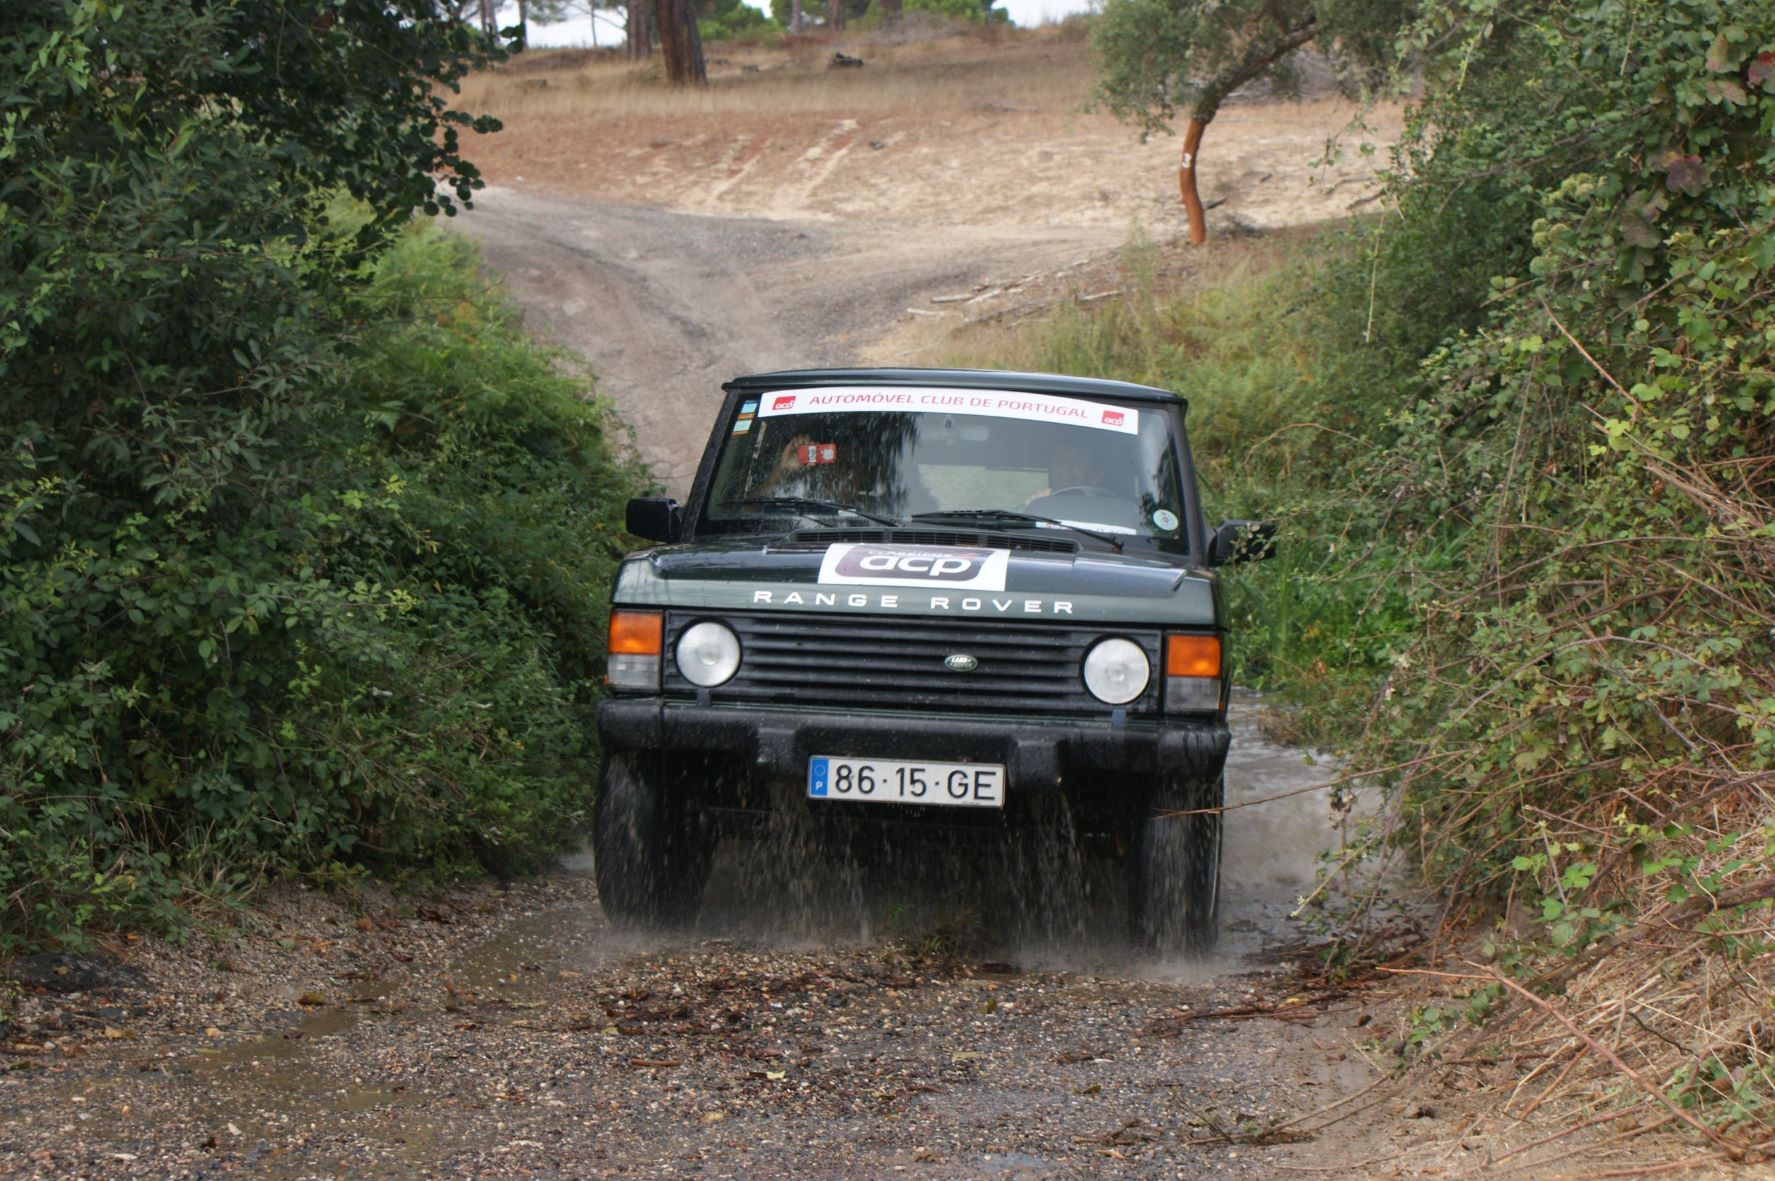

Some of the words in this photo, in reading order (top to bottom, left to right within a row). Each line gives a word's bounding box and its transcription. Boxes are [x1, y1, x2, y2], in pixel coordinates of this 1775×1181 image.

[809, 392, 914, 405] AUTOMÓVEL
[920, 395, 964, 406] CLUB
[970, 397, 992, 408] DE
[997, 399, 1088, 418] PORTUGAL
[860, 555, 971, 576] acp
[753, 590, 899, 609] RANGE
[930, 597, 1073, 614] ROVER
[815, 780, 823, 790] P
